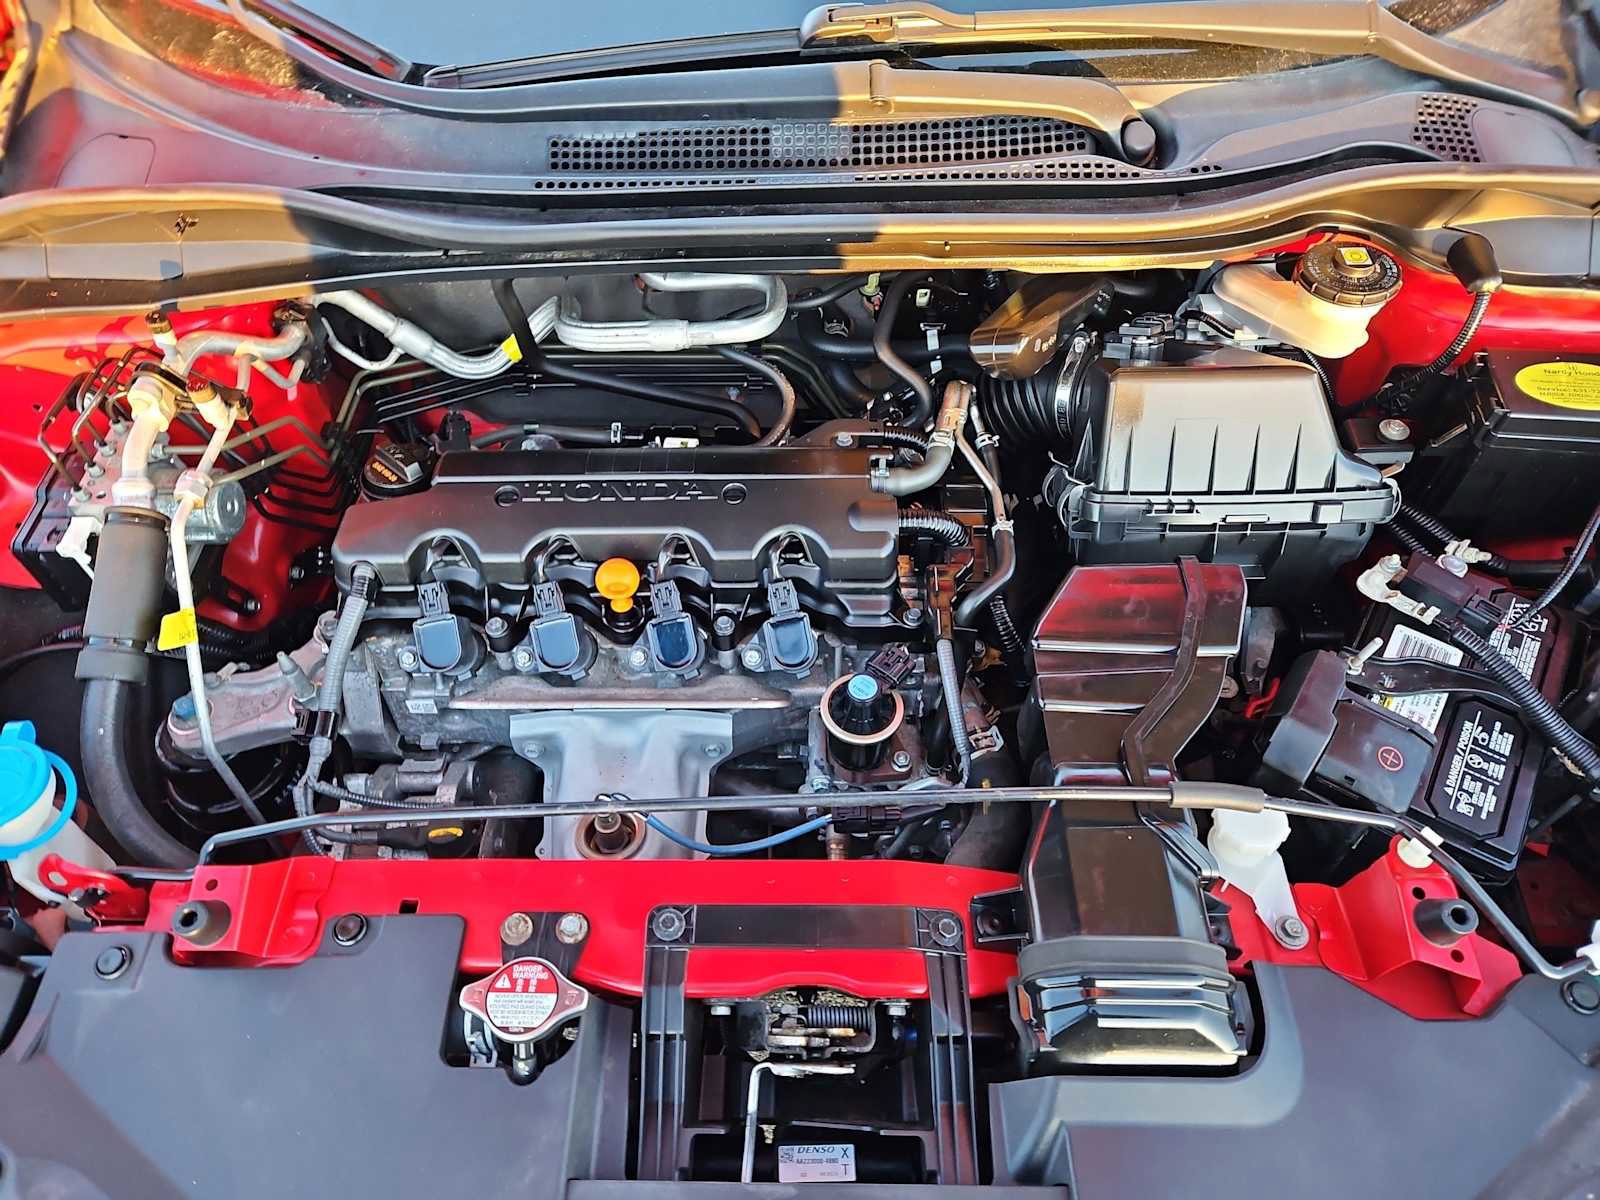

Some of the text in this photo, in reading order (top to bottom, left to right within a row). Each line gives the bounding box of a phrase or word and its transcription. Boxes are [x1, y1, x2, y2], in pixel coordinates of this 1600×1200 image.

[521, 482, 719, 502] HONDA
[1445, 753, 1463, 787] DANGER
[1457, 719, 1474, 749] POISON
[512, 965, 543, 973] DANGER
[797, 1146, 835, 1154] DENSO
[841, 1147, 849, 1159] X
[841, 1163, 849, 1176] T
